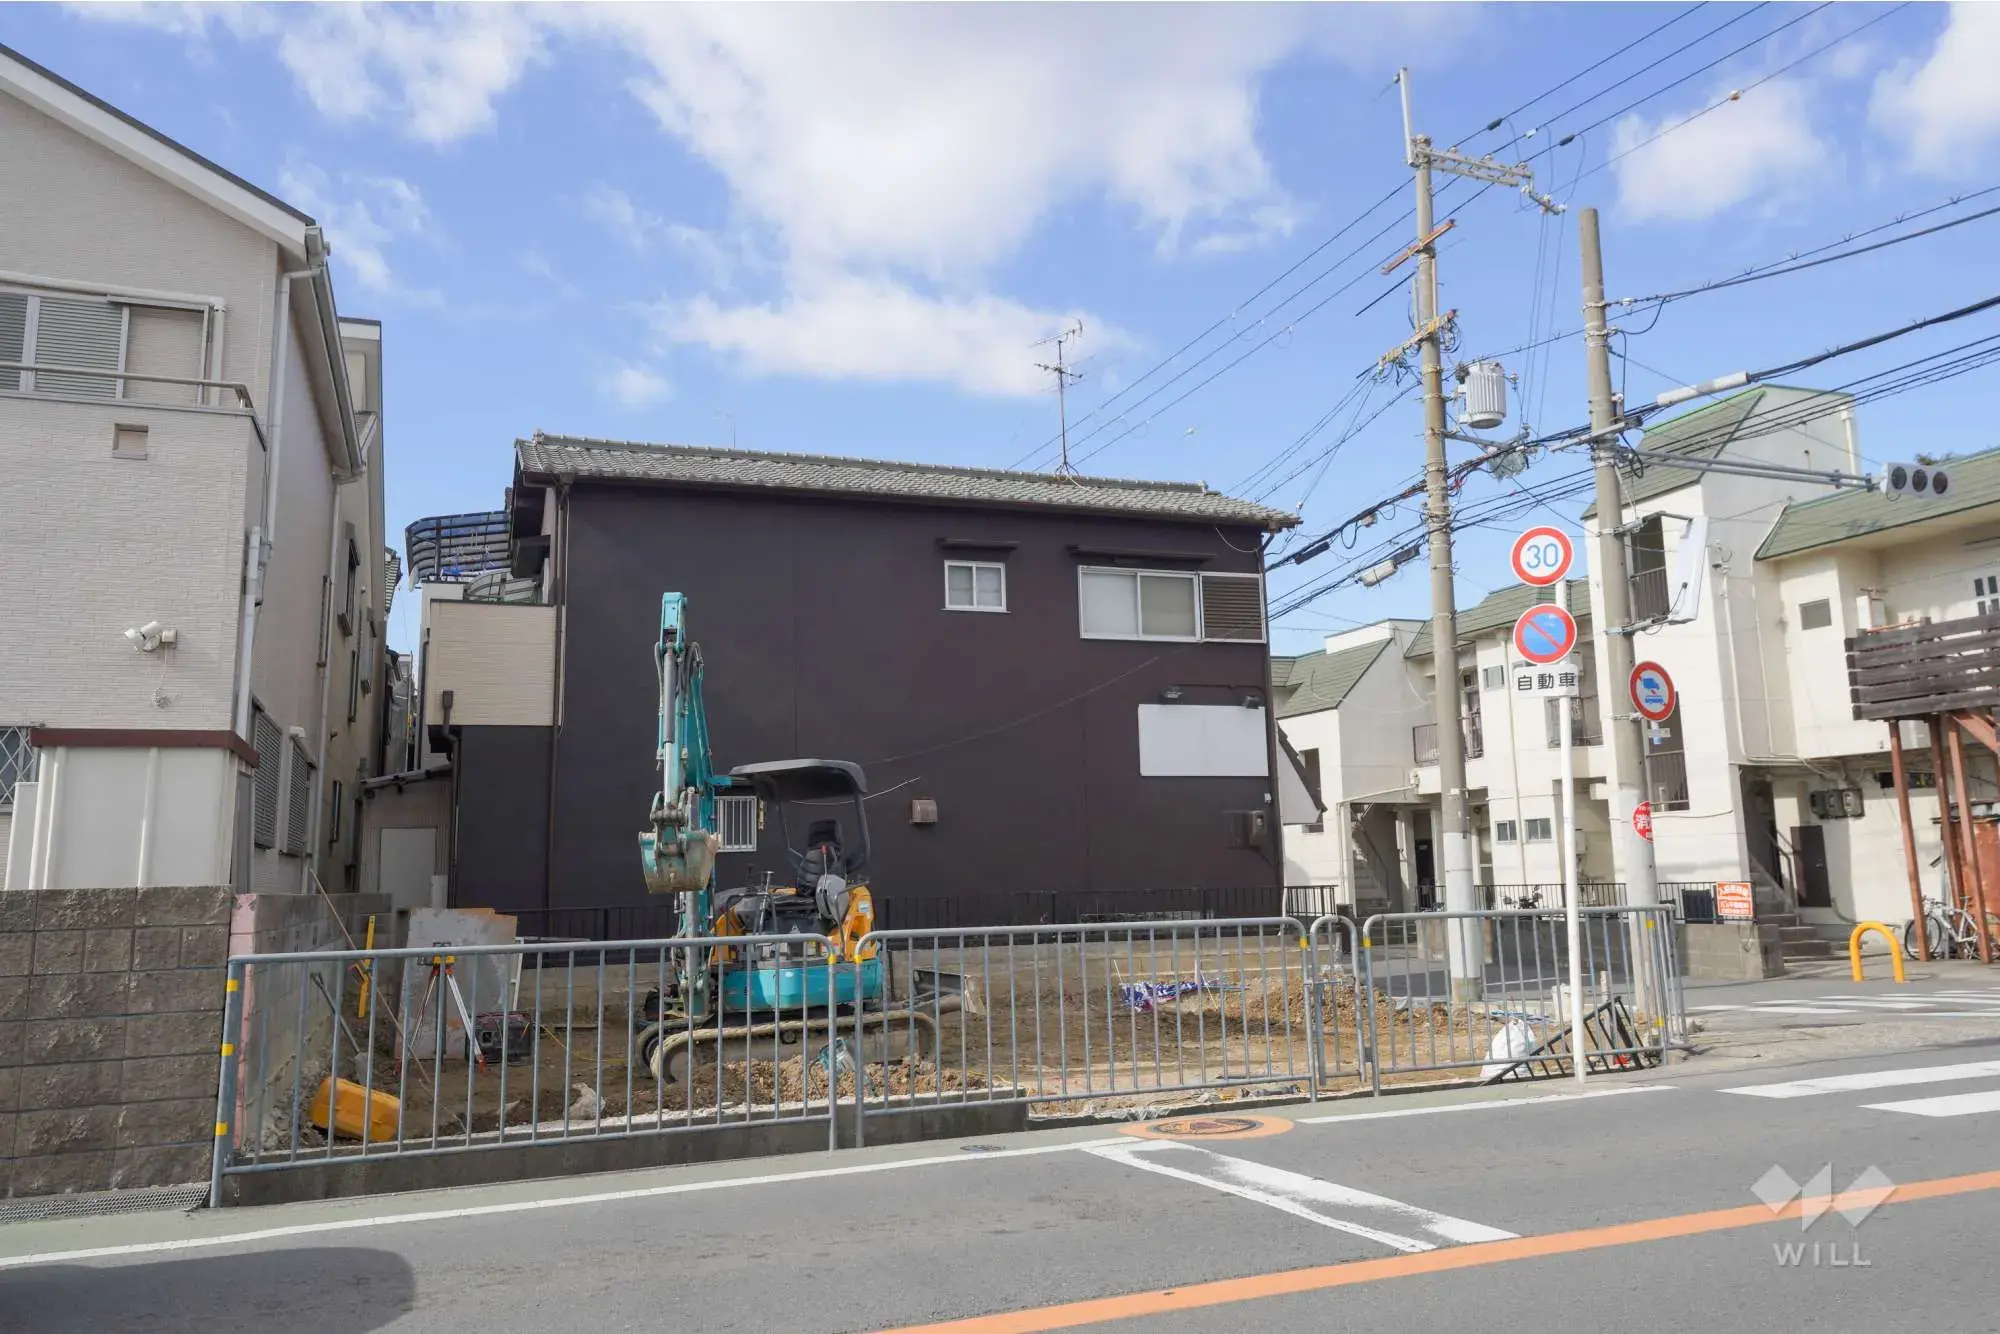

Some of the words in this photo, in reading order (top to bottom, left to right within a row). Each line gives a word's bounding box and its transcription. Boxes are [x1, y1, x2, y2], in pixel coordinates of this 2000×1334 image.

[1526, 543, 1558, 569] 30
[1517, 672, 1577, 691] 自動車
